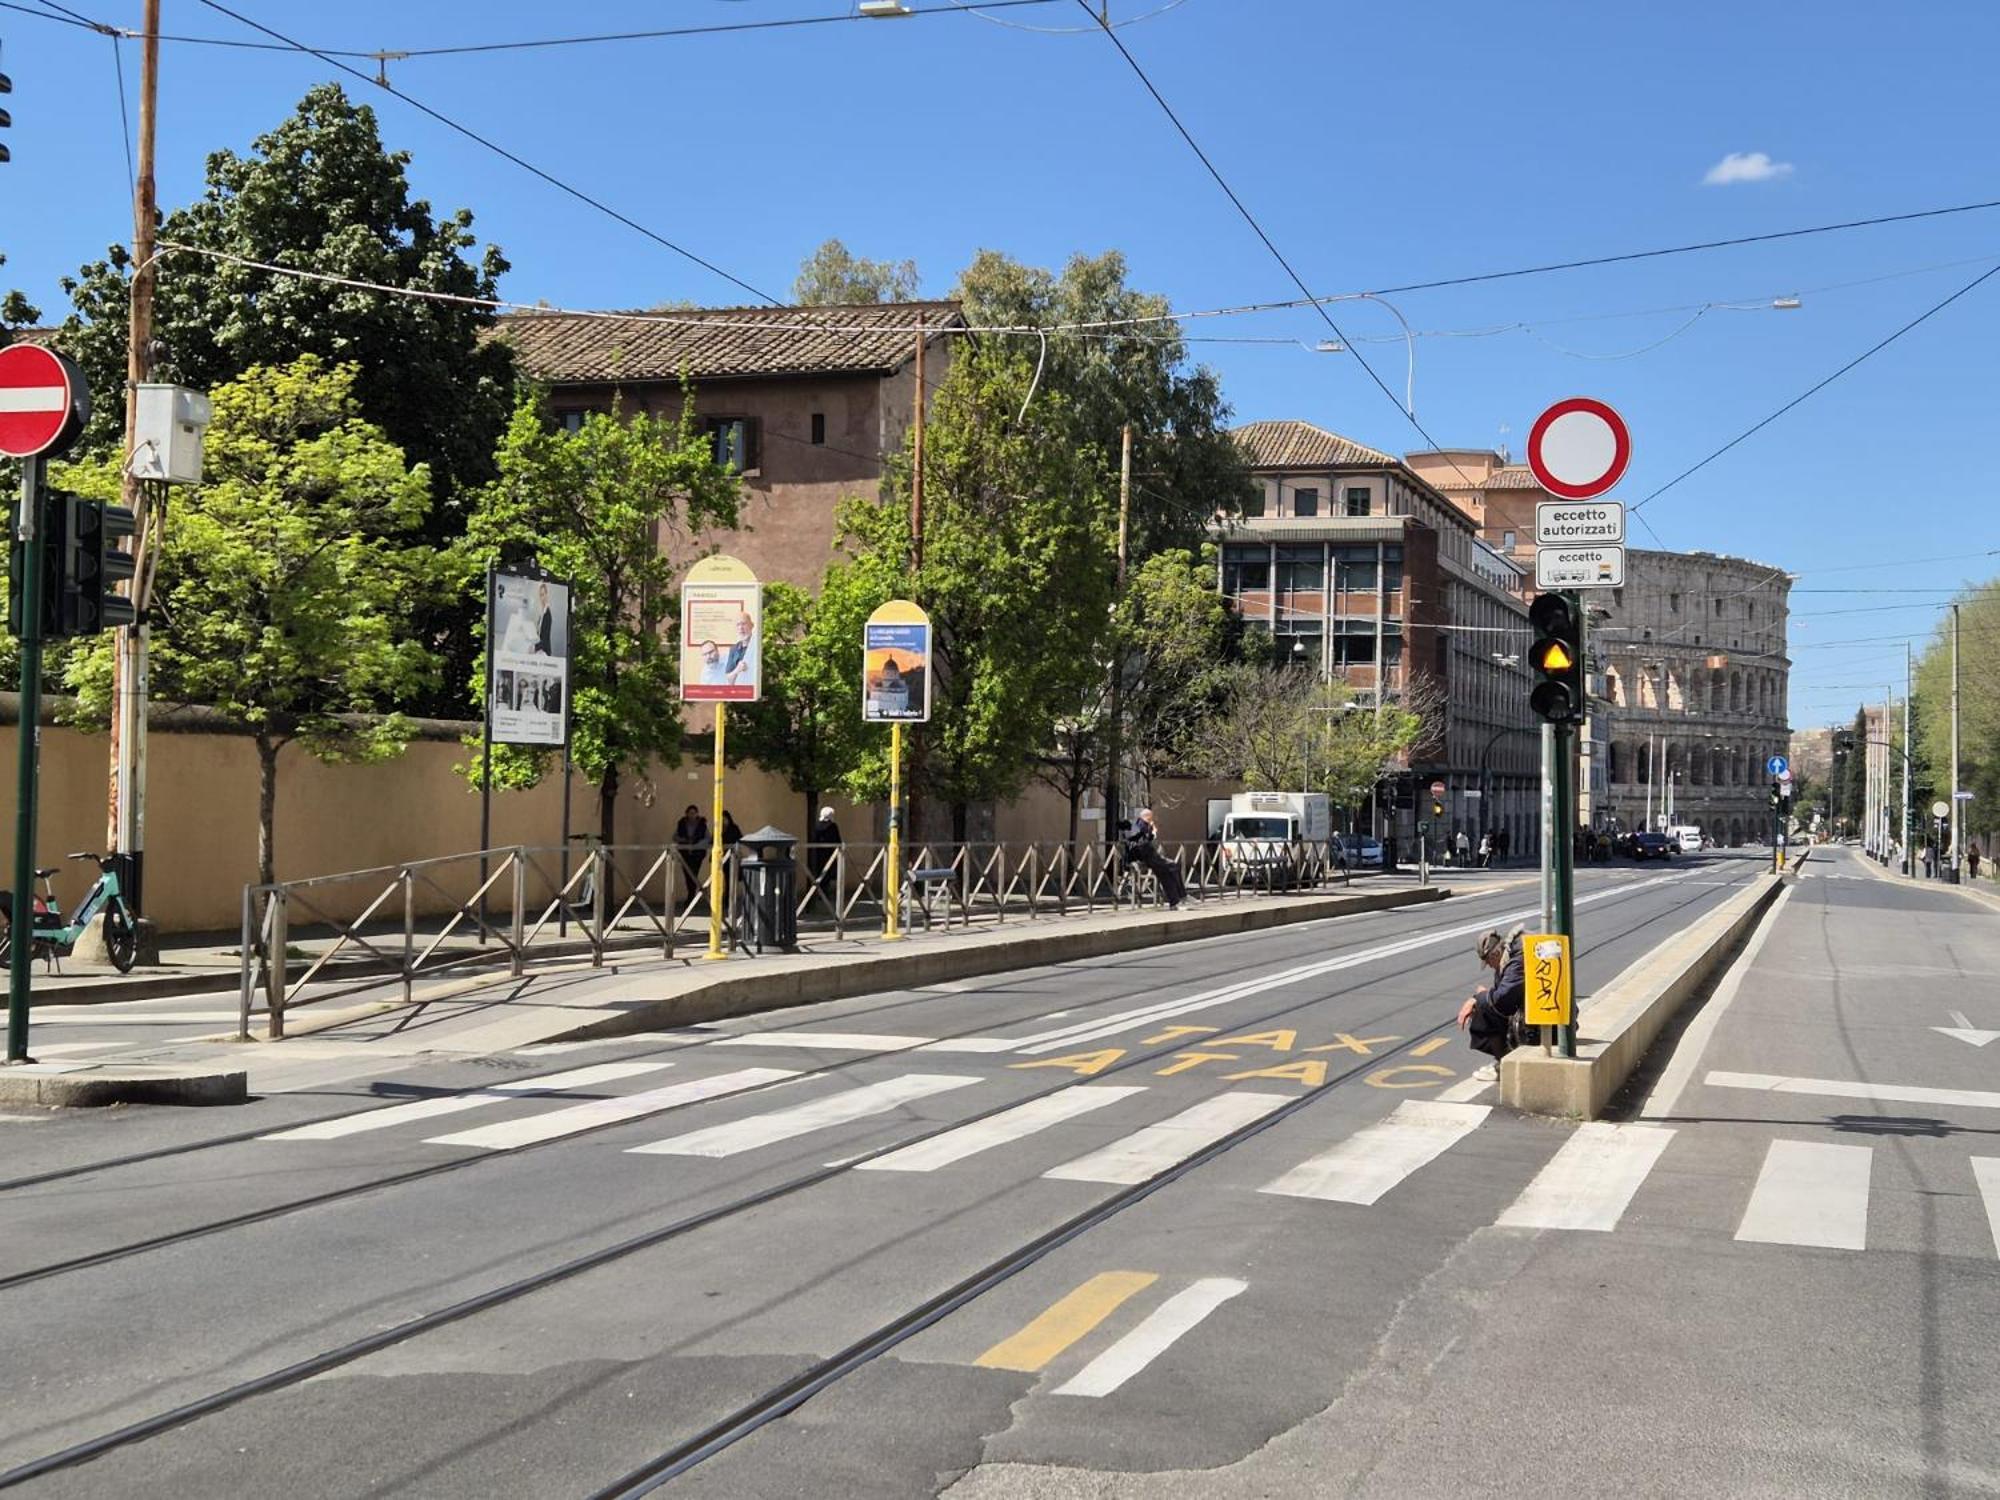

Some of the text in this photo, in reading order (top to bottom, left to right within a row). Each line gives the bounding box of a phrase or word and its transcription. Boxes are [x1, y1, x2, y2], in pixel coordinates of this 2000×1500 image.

[1553, 509, 1607, 522] eccetto
[1543, 522, 1617, 536] autorizzati
[1558, 551, 1603, 563] eccetto
[1141, 1025, 1450, 1057] TAXI
[1008, 1048, 1457, 1089] ATAC
